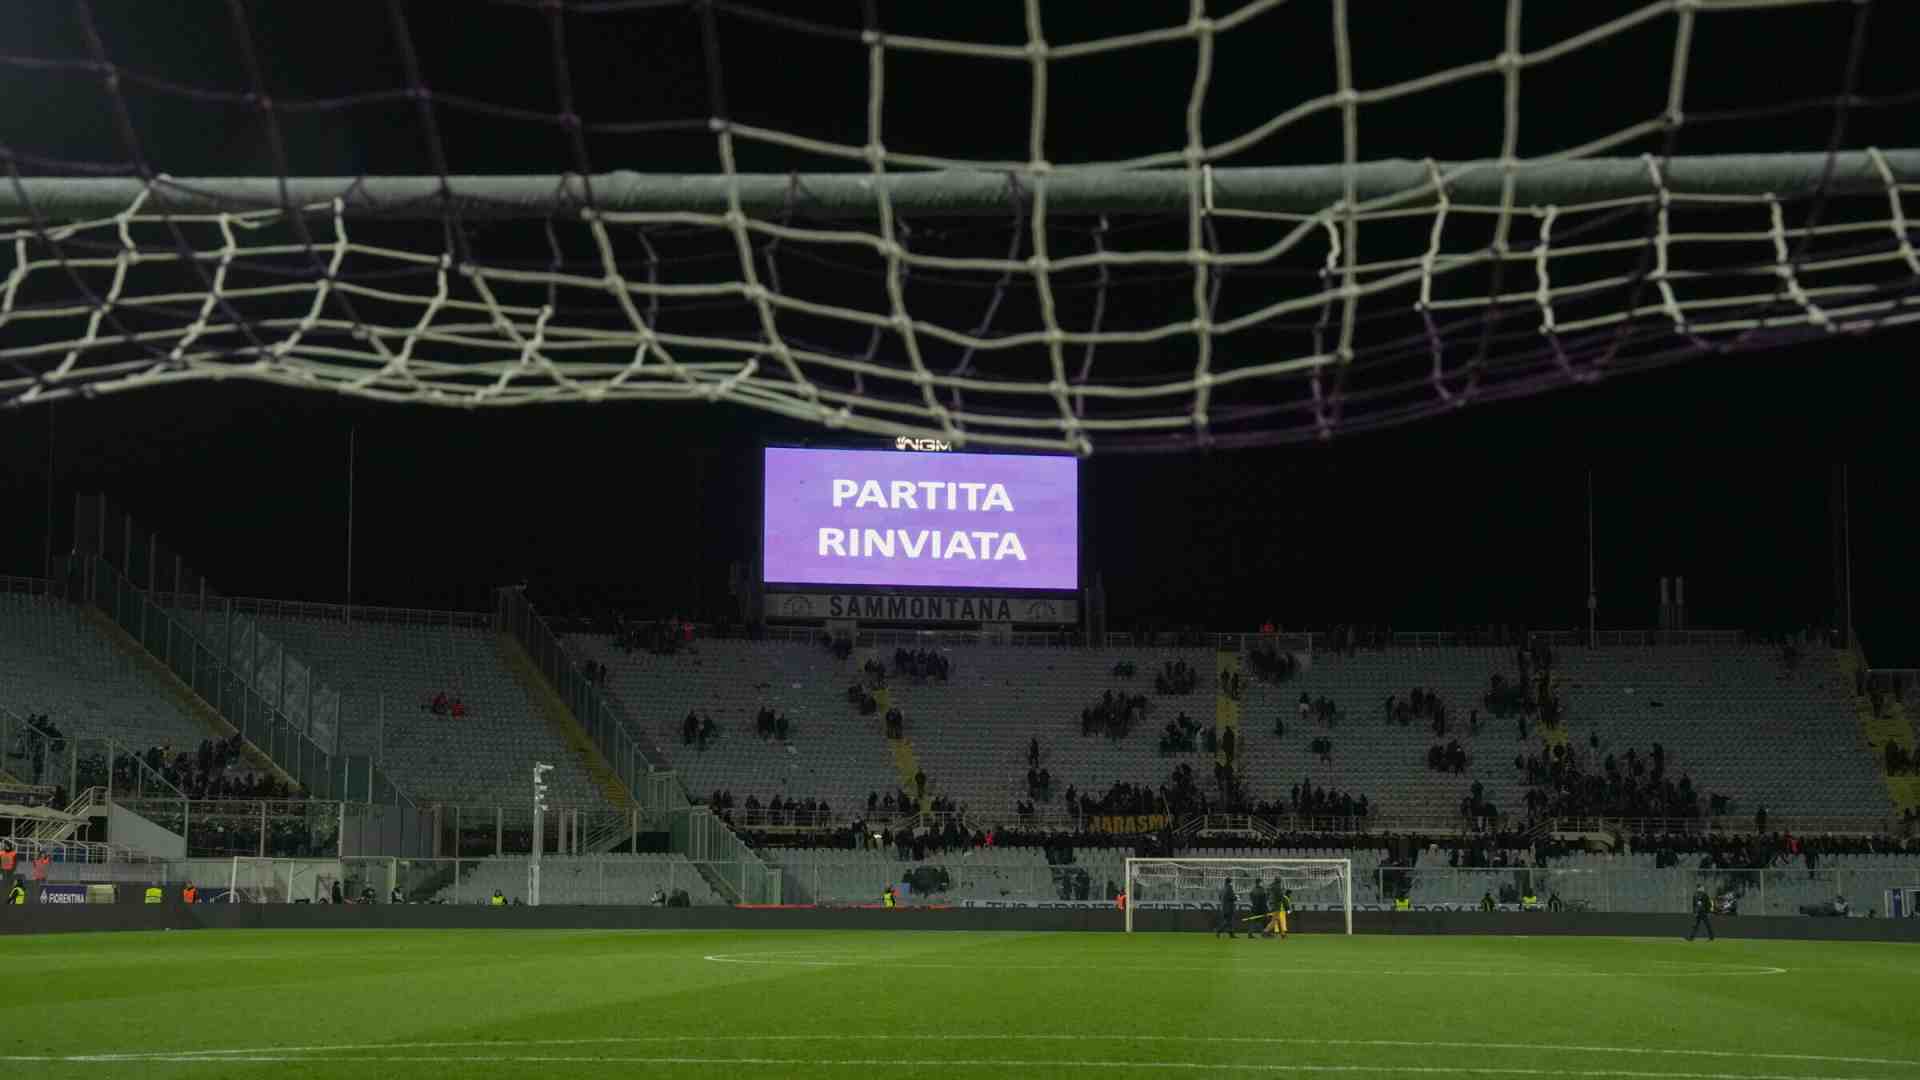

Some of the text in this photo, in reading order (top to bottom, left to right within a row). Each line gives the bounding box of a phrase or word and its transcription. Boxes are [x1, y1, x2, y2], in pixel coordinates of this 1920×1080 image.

[904, 437, 953, 452] NGM
[832, 479, 1015, 512] PARTITA
[817, 527, 1028, 561] RINVIATA
[829, 594, 1012, 622] SAMMONTANA
